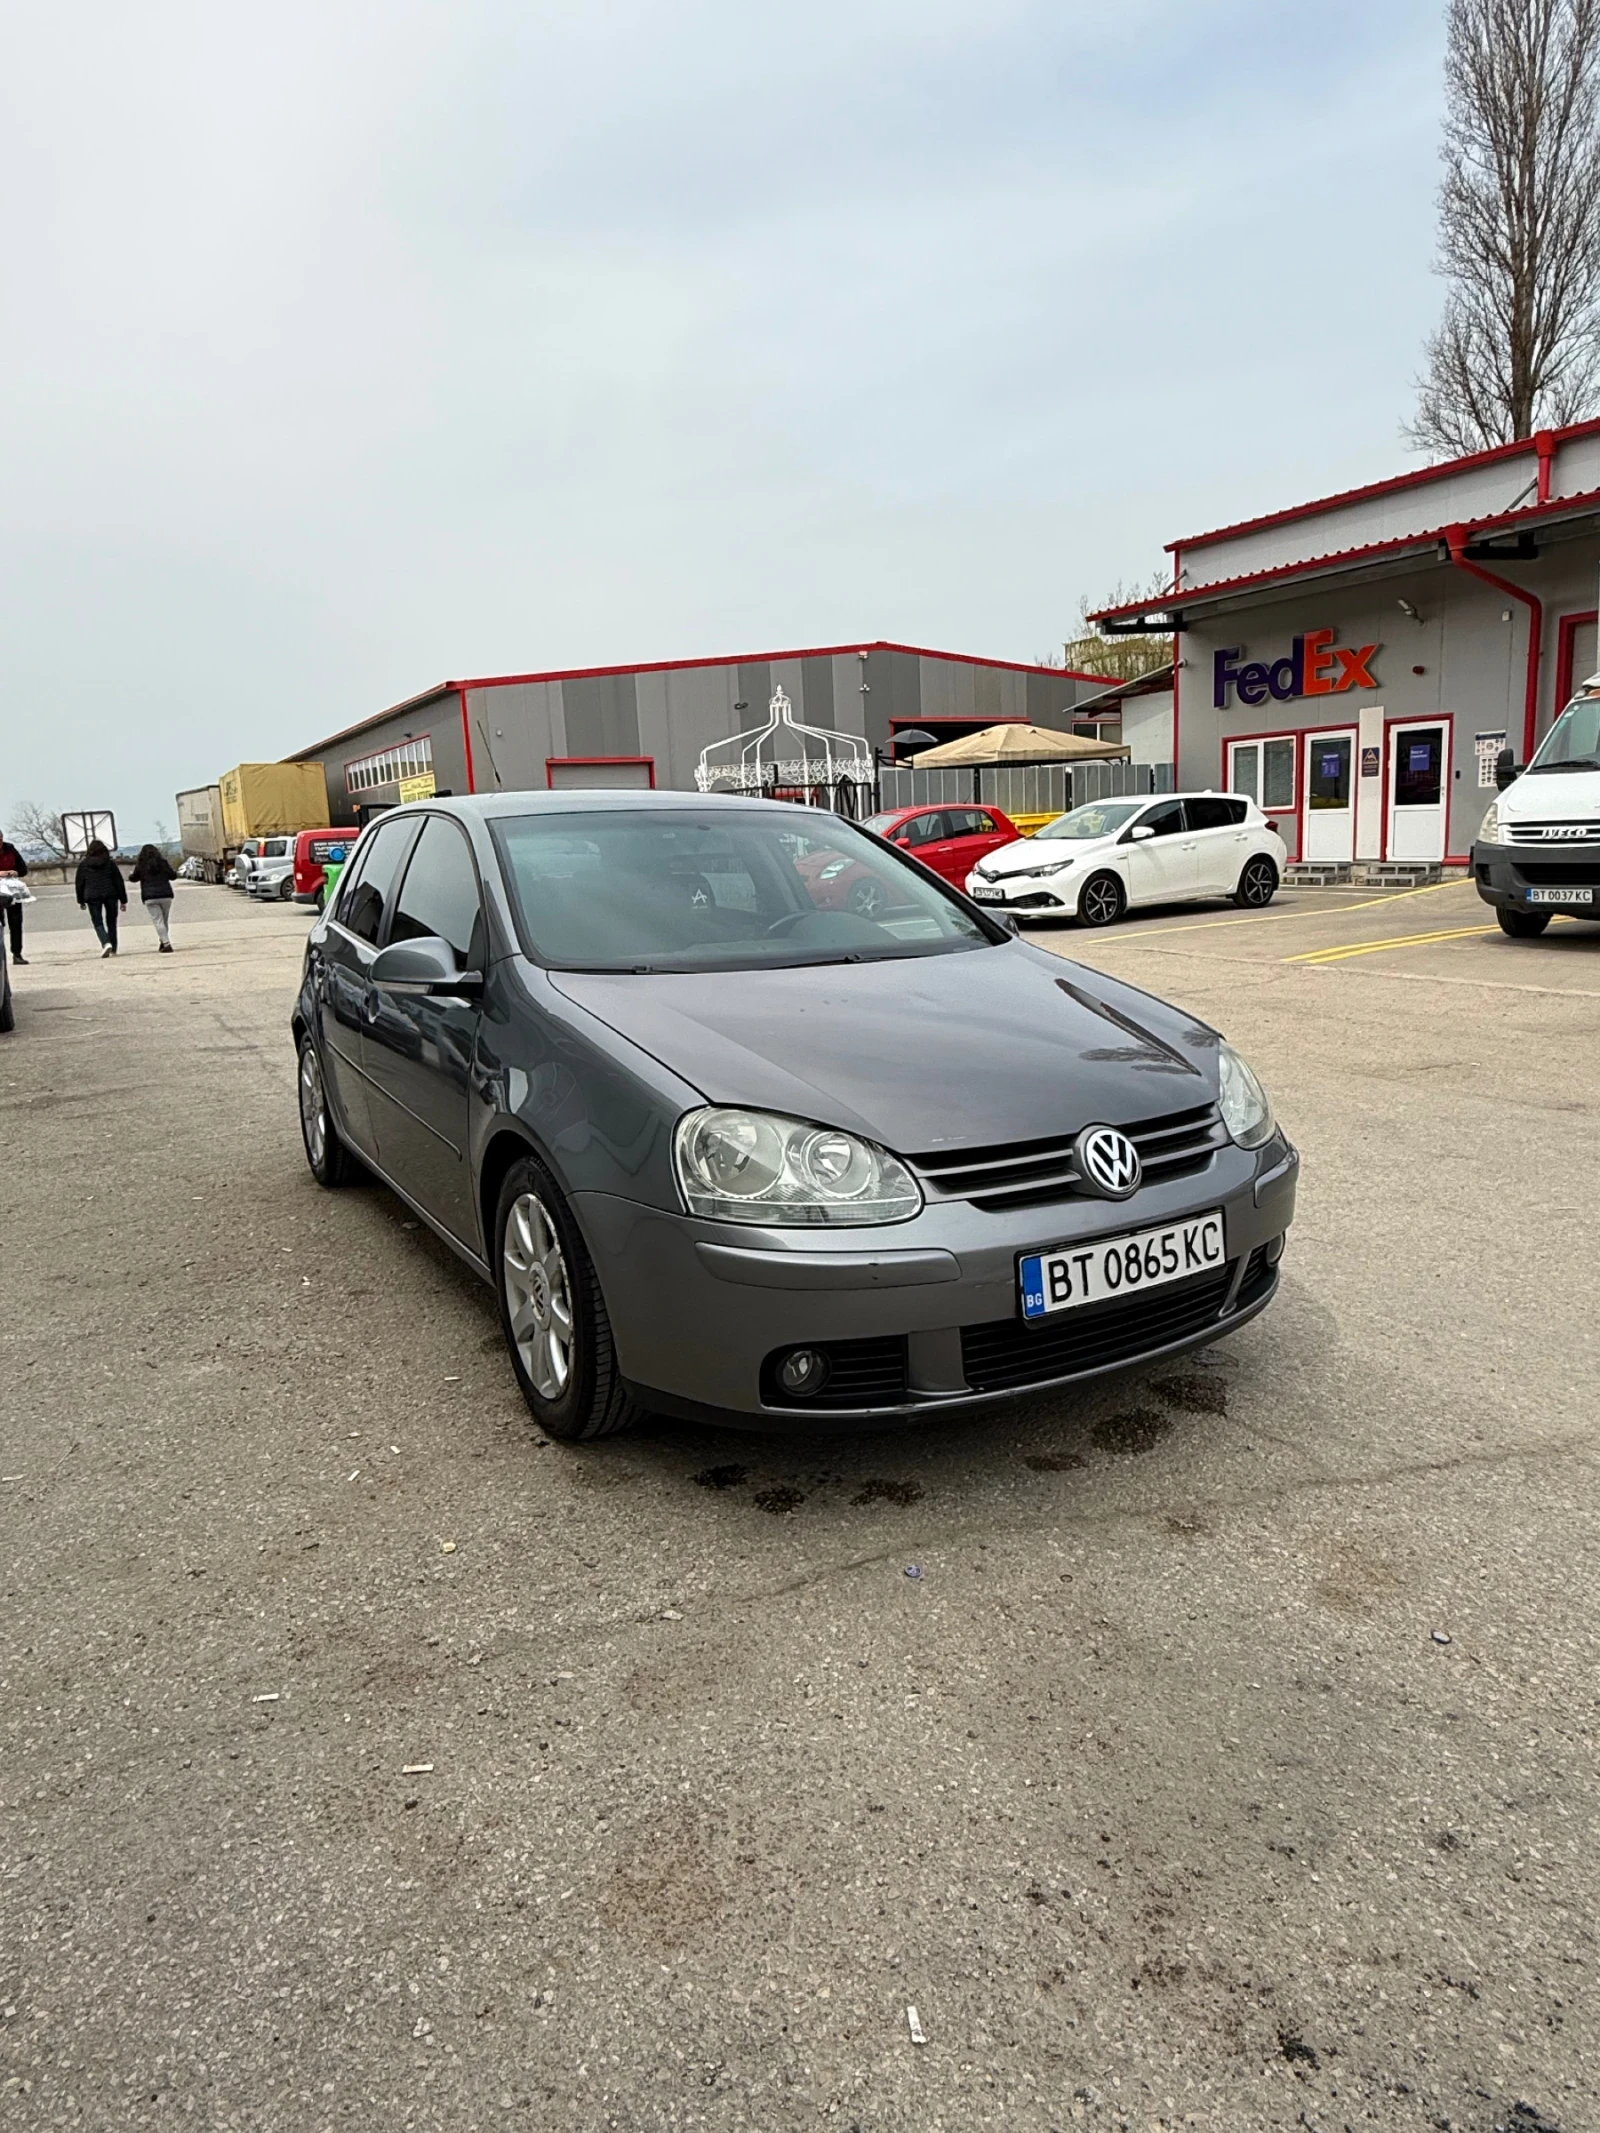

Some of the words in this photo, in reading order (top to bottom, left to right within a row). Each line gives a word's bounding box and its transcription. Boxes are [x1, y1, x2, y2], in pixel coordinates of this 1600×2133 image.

[1213, 628, 1378, 708] FedEx
[1542, 829, 1587, 839] IVECO
[1532, 890, 1546, 900] BT
[1548, 890, 1574, 901] 0037
[1575, 890, 1591, 901] KC
[1047, 1252, 1094, 1304] BT
[1104, 1232, 1179, 1289] 0865
[1183, 1221, 1220, 1269] KC
[1026, 1292, 1043, 1308] BG
